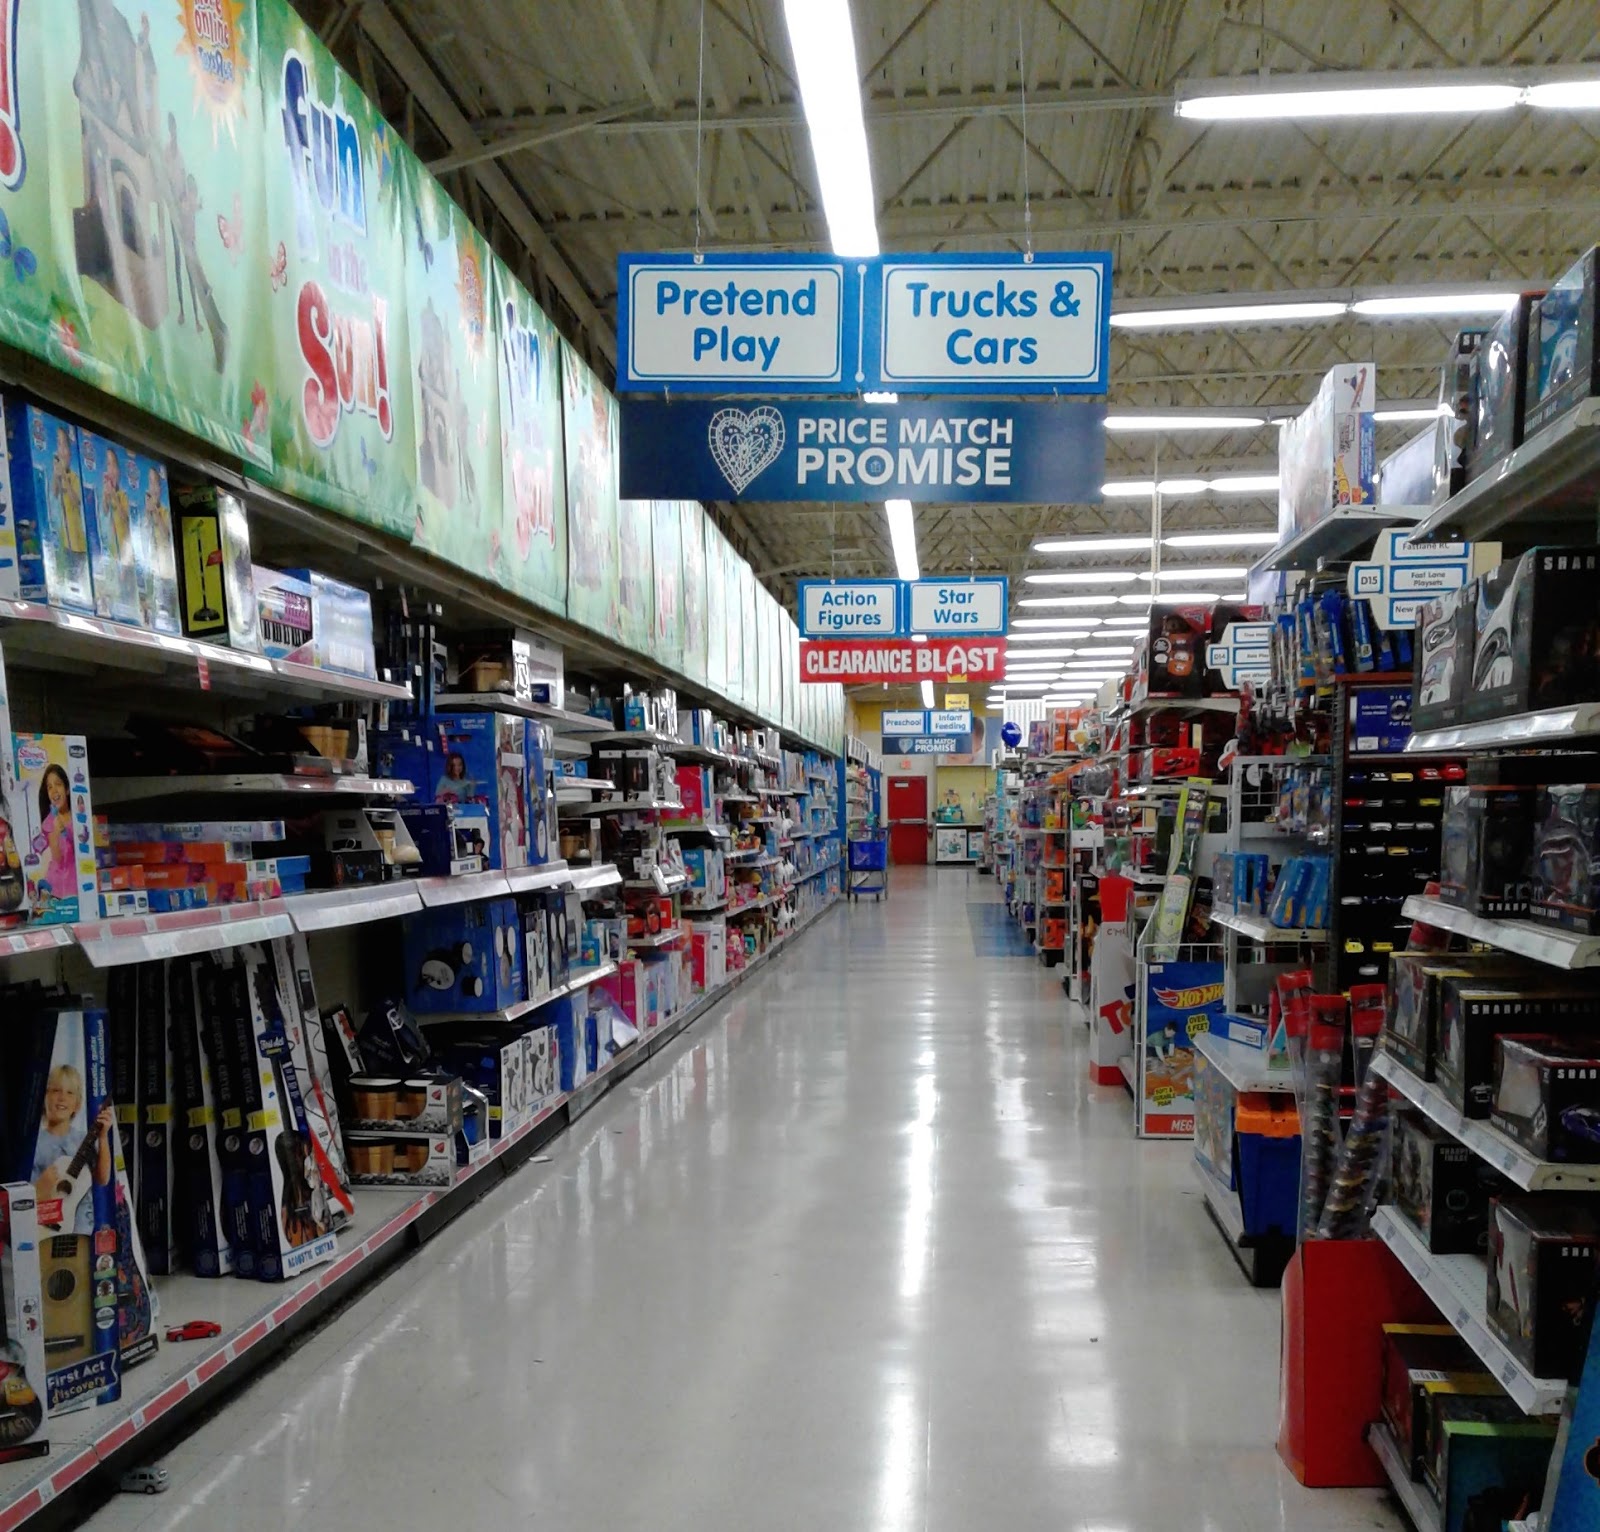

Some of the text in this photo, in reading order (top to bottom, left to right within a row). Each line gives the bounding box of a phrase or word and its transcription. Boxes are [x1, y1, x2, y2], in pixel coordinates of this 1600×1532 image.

[656, 279, 817, 317] Pretend
[905, 280, 1082, 319] Trucks &
[693, 327, 782, 372] Play
[945, 329, 1039, 365] Cars
[296, 282, 391, 445] Sun!
[797, 417, 1014, 445] PRICE MATCH
[797, 447, 1012, 486] PROMISE
[1360, 576, 1378, 585] D15
[821, 590, 877, 607] Action
[938, 589, 975, 605] Star
[818, 610, 882, 630] Figures
[933, 609, 979, 624] Wars
[806, 645, 999, 675] CLEARANCE BLAST
[886, 717, 922, 727] Preschool
[935, 723, 967, 731] Feeding
[915, 745, 956, 753] PROMISE
[1177, 989, 1202, 1008] HOT
[1189, 1015, 1206, 1023] OVER
[1192, 1023, 1208, 1031] FEET
[47, 1360, 106, 1391] First Act
[52, 1375, 106, 1405] discovery
